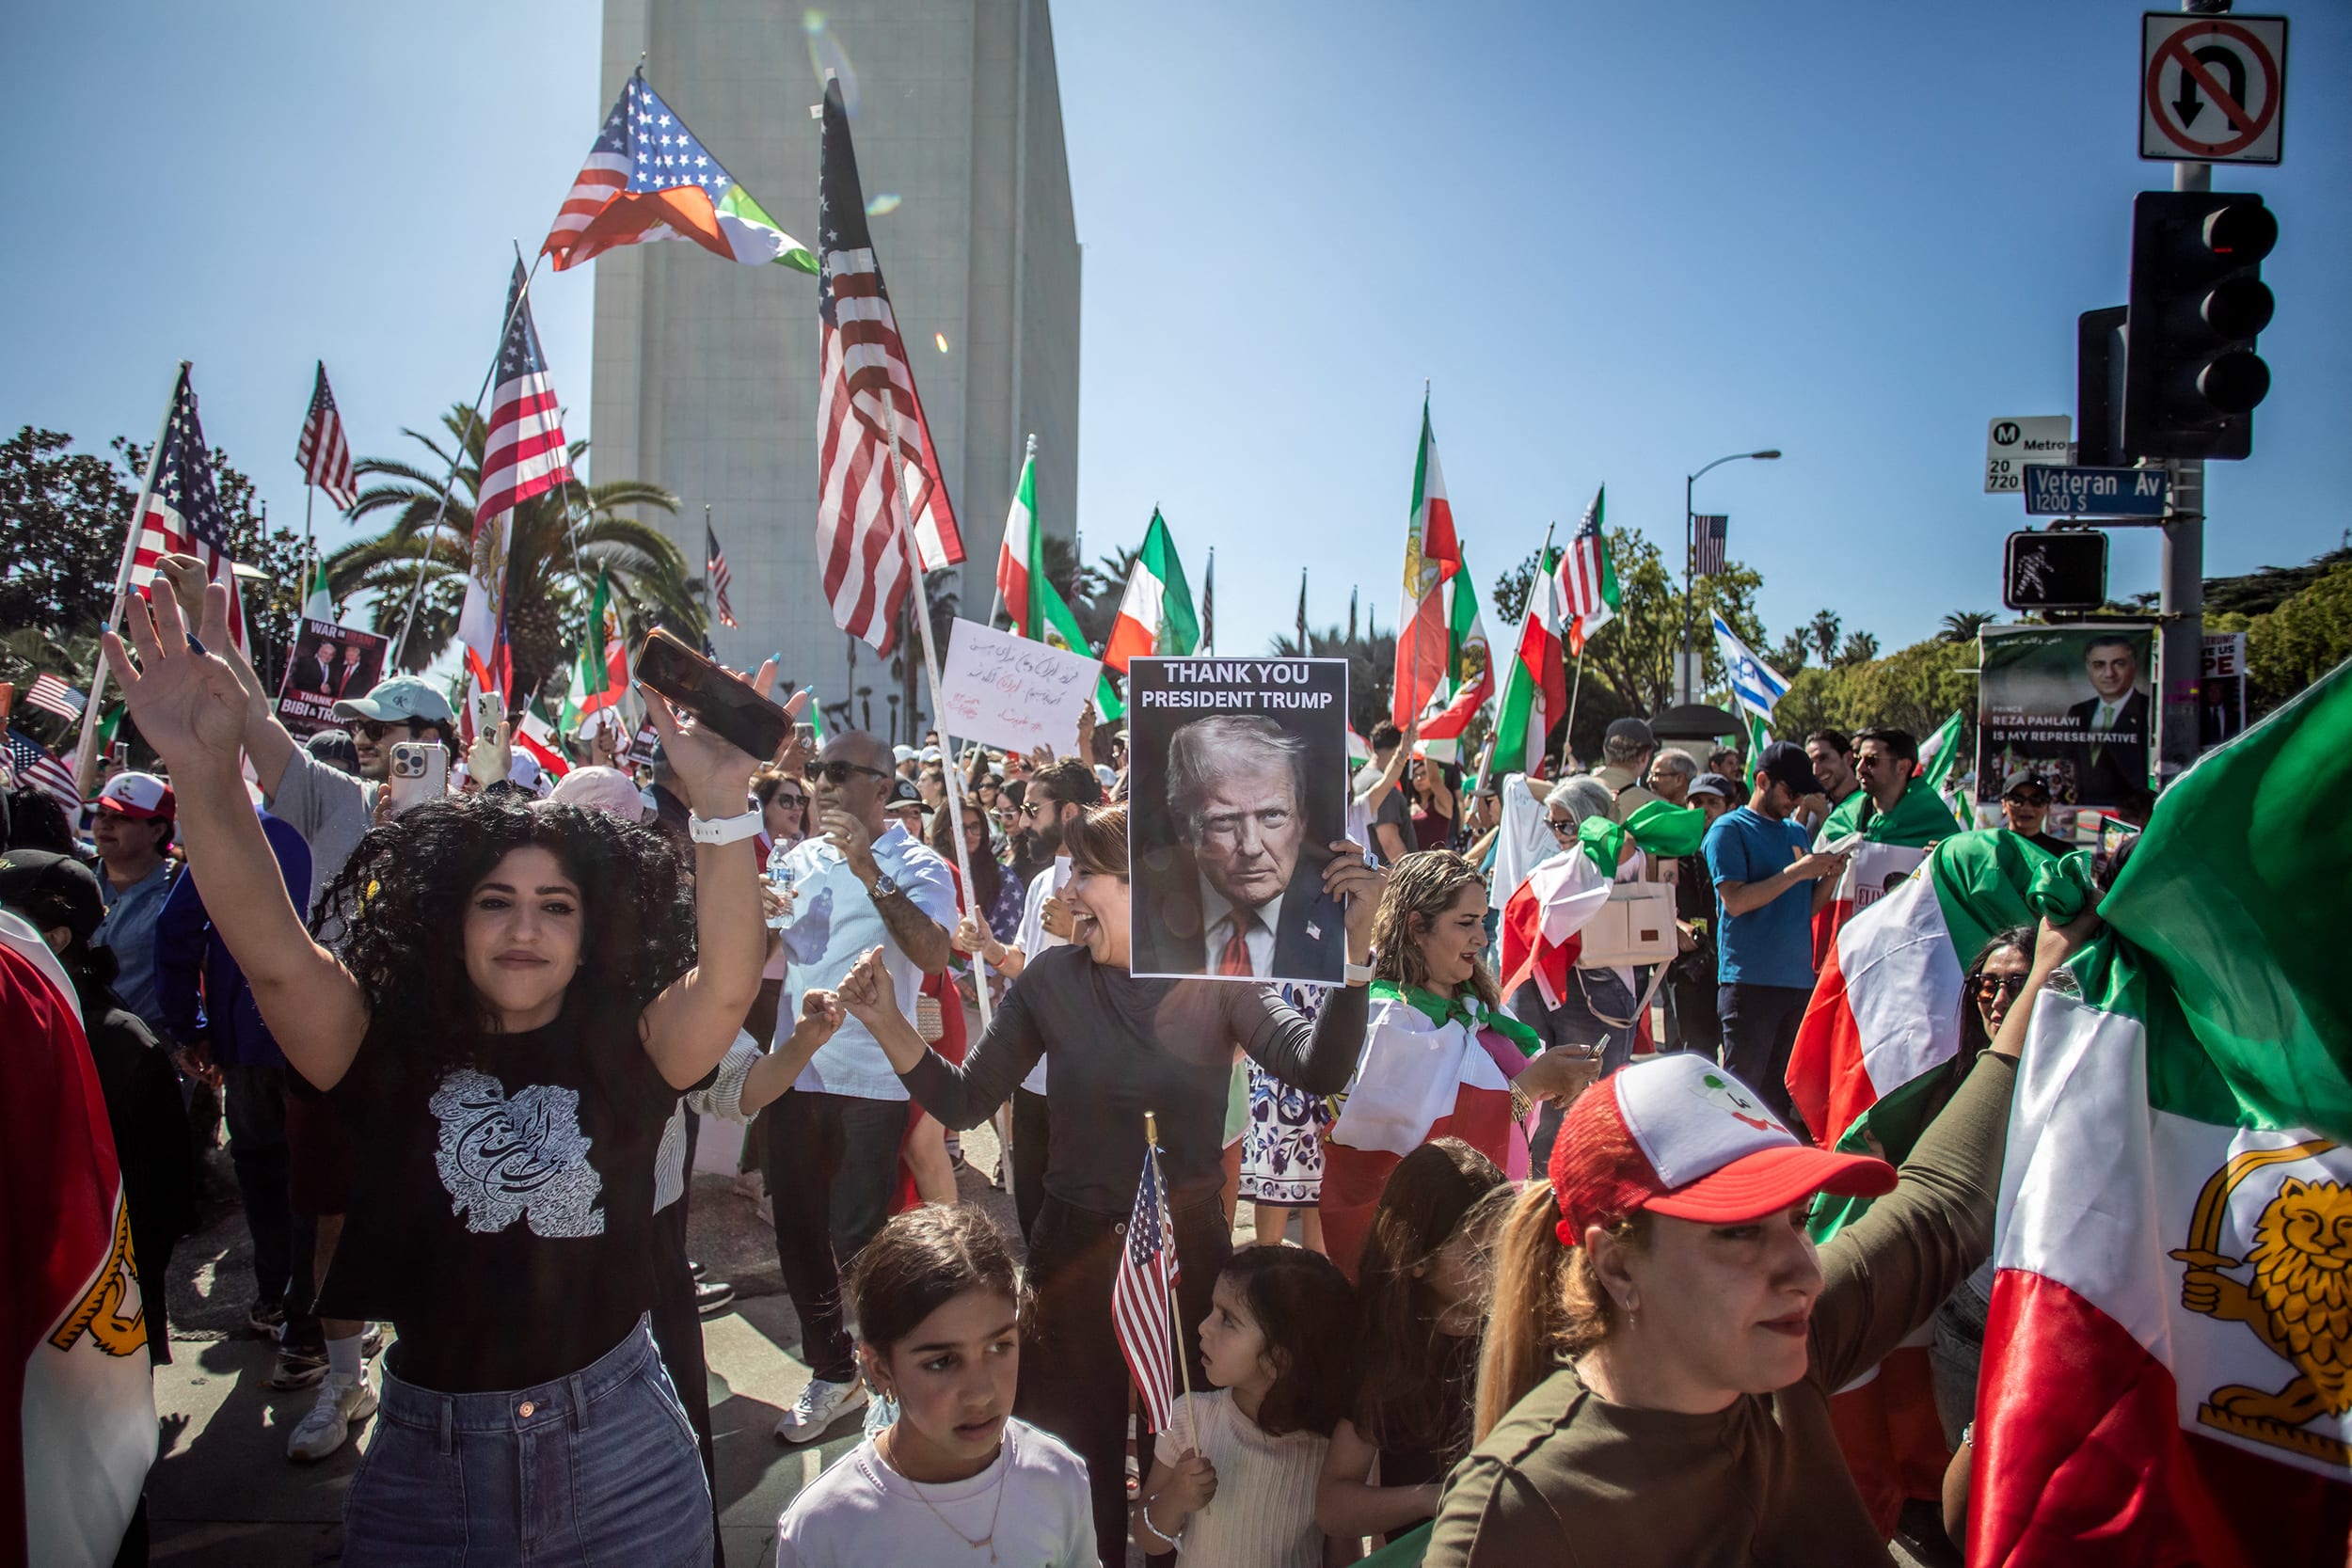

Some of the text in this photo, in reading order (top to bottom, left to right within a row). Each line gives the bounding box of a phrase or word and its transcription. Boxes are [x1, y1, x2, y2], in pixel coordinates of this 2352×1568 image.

[2025, 439, 2066, 451] Metro
[1990, 460, 2010, 473] 20
[1989, 475, 2019, 488] 720
[2037, 469, 2161, 497] Veteran Av
[2036, 494, 2088, 512] 1200 S
[310, 620, 337, 639] WAR
[2217, 645, 2235, 655] US
[1163, 662, 1310, 685] THANK YOU
[300, 690, 332, 706] THANK
[1141, 690, 1333, 709] PRESIDENT TRUMP
[280, 698, 310, 717] BIBI
[1993, 715, 2080, 727] REZA PAHLAVI
[1993, 731, 2137, 744] IS MY REPRESENTATIVE
